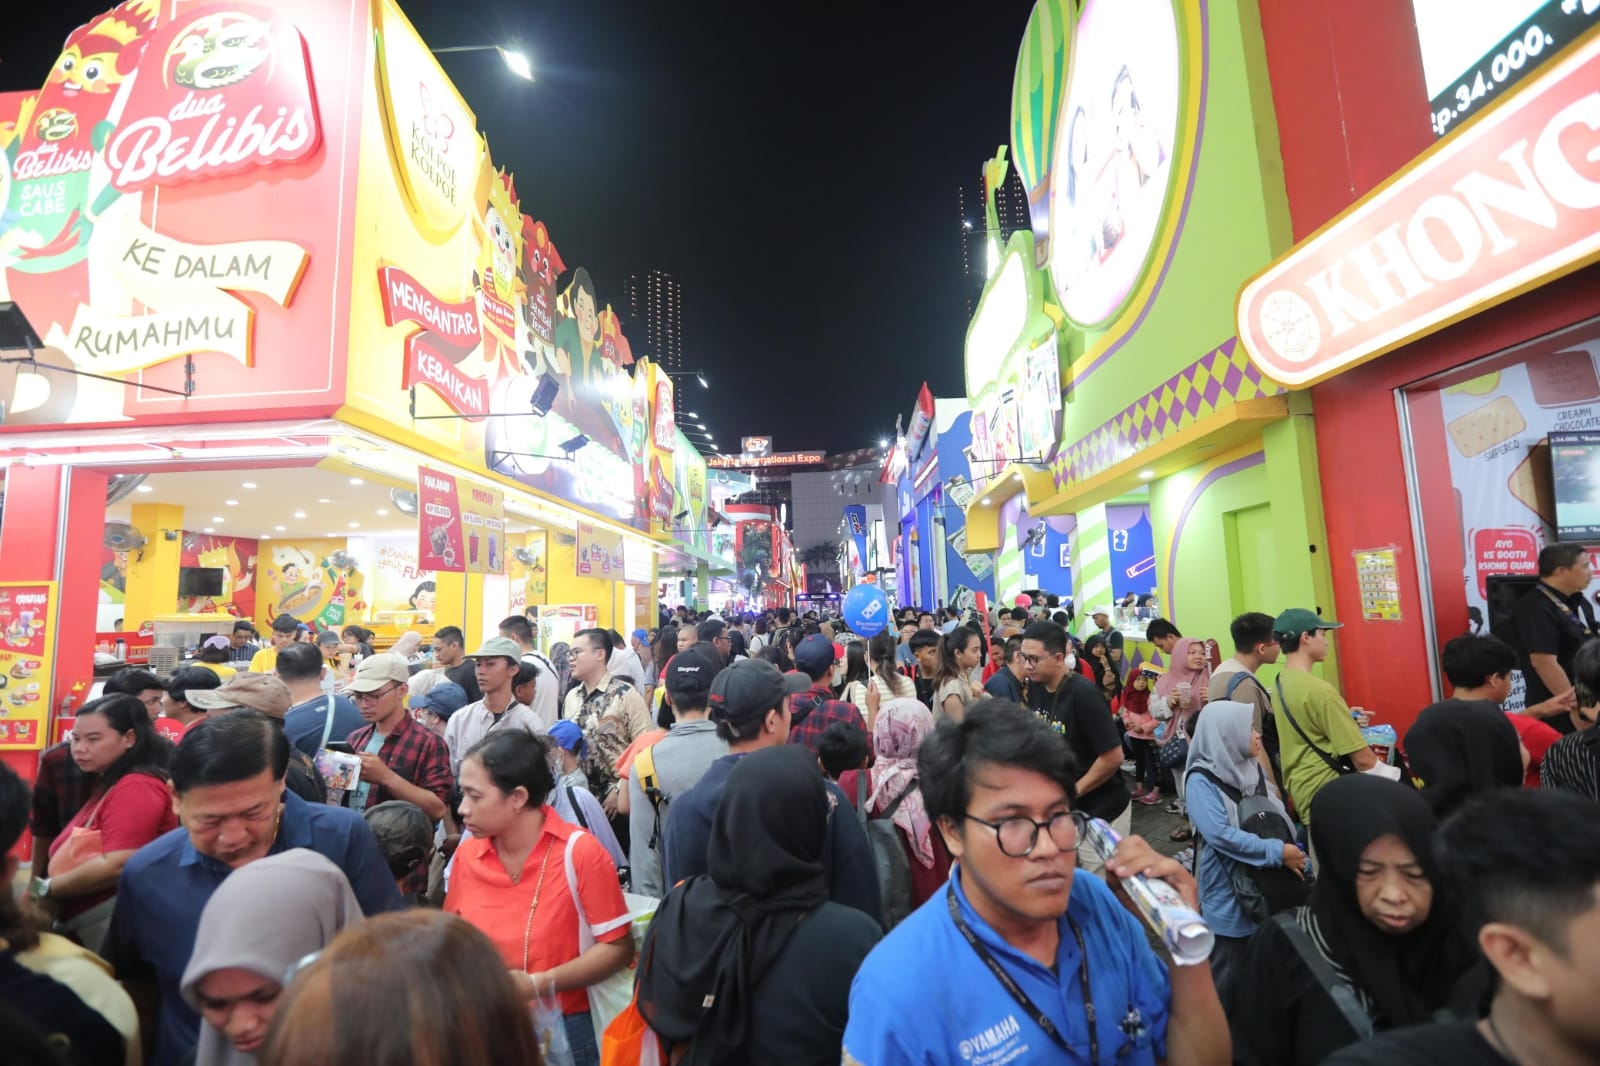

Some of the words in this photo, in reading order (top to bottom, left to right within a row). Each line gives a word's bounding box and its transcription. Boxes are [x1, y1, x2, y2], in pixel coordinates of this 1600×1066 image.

[168, 92, 226, 122] dua
[108, 106, 309, 185] Belibis
[14, 147, 92, 181] Belibis
[21, 180, 66, 201] SAUS
[20, 197, 66, 217] CABE
[1305, 92, 1600, 337] KHONG
[123, 238, 166, 276] KE
[174, 254, 273, 281] DALAM
[391, 281, 478, 336] MENGANTAR
[75, 317, 236, 359] RUMAHMU
[417, 351, 483, 412] KEBAIKAN
[708, 459, 740, 468] Jakarta
[741, 454, 796, 467] International
[797, 453, 821, 464] Expo
[1484, 440, 1520, 461] SUPERCO
[1483, 551, 1494, 560] KE
[1497, 550, 1527, 559] BOOTH
[1495, 540, 1513, 549] AYO
[1478, 561, 1508, 571] KHONG
[1510, 561, 1535, 570] GUAN
[970, 1014, 1020, 1053] YAMAHA
